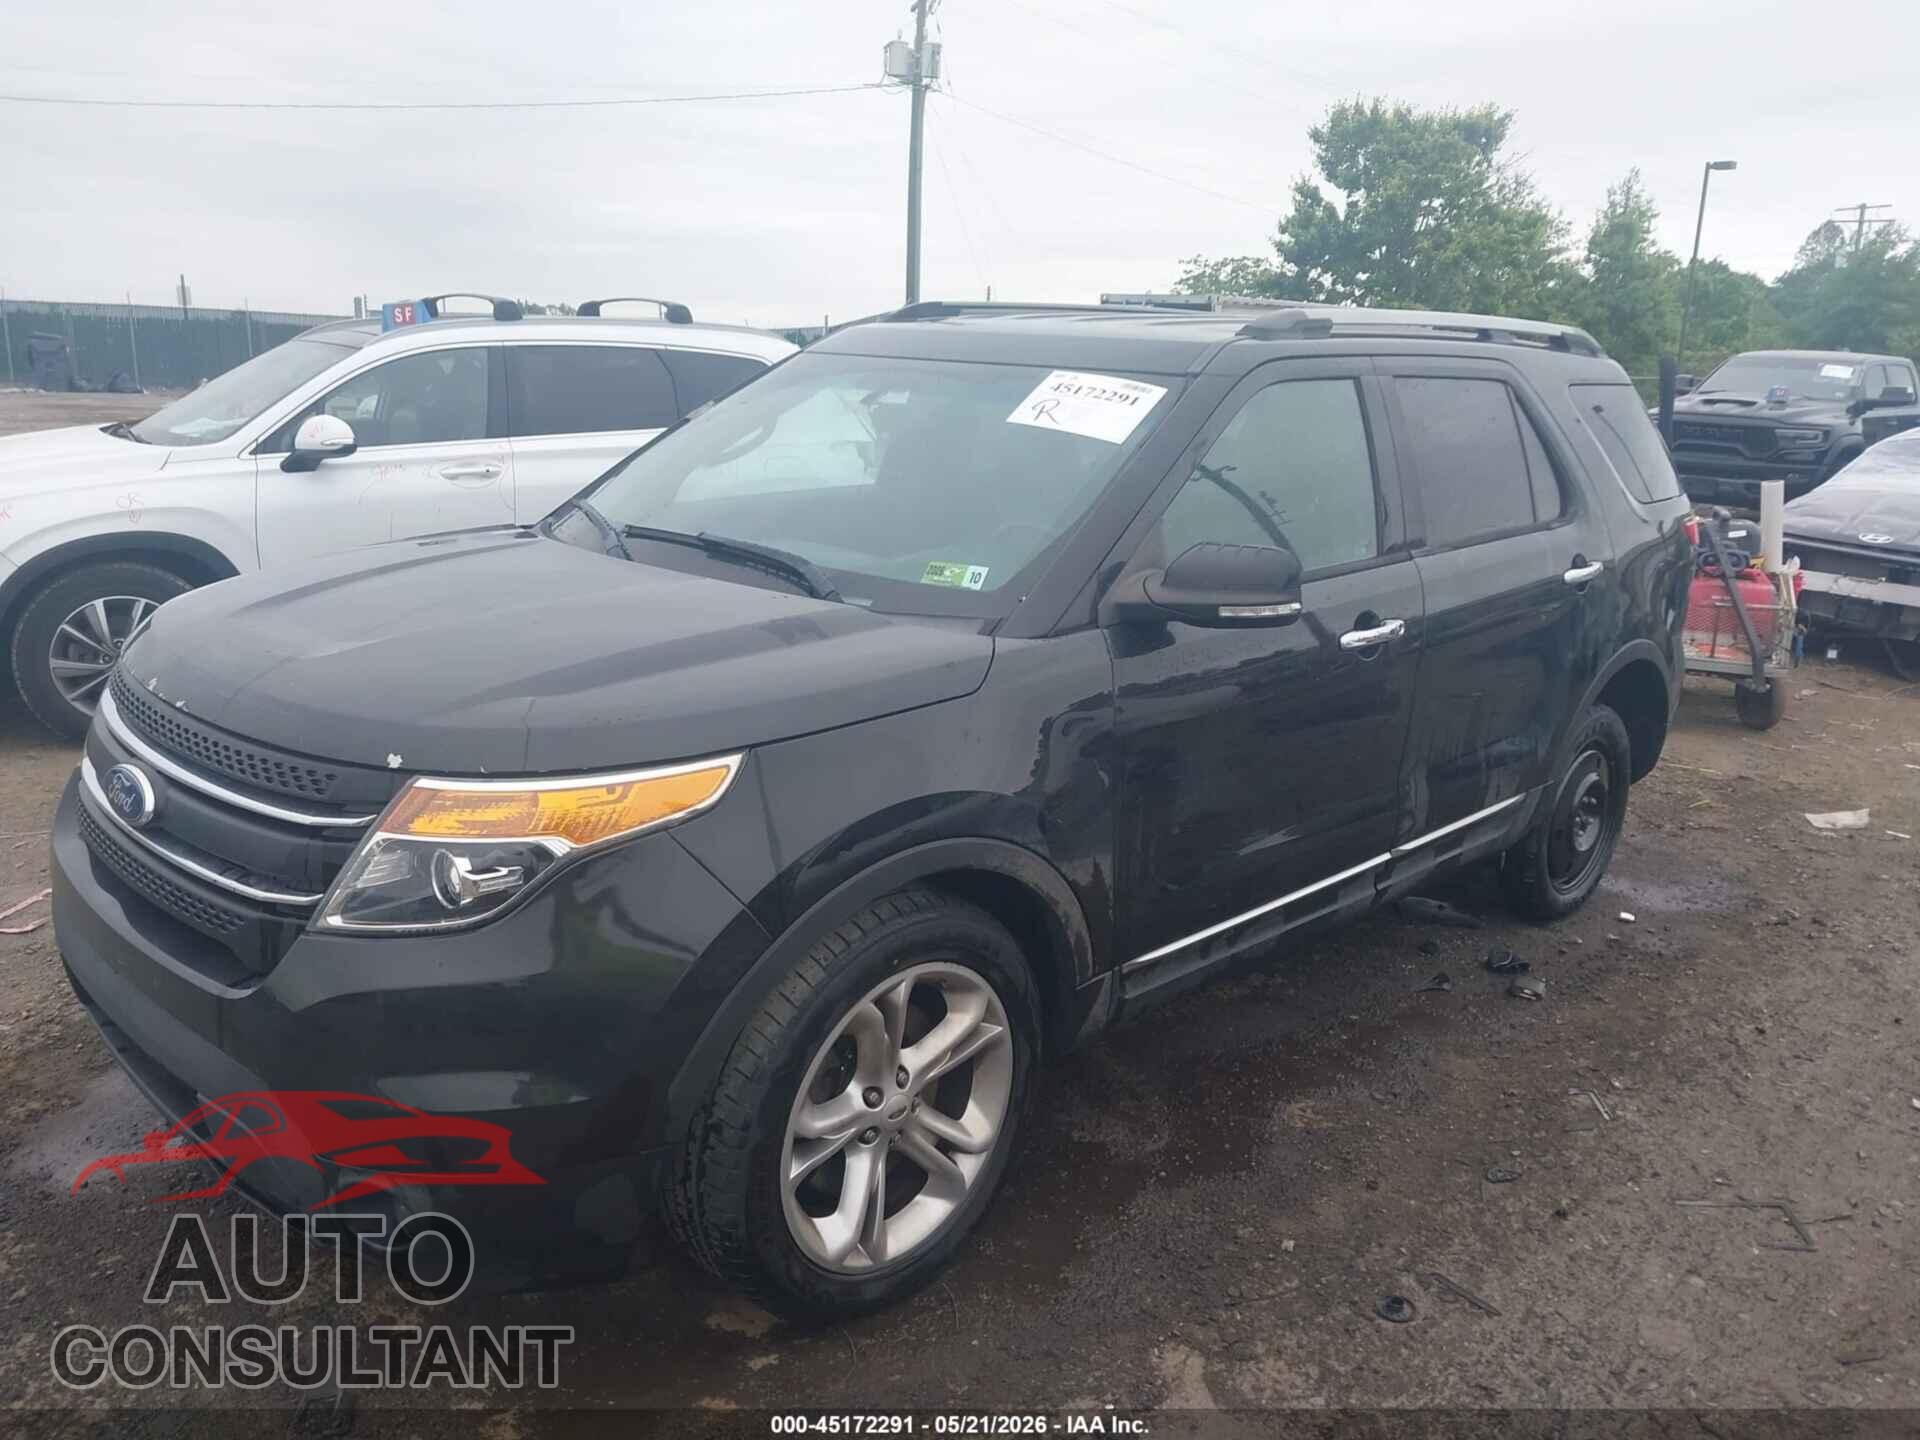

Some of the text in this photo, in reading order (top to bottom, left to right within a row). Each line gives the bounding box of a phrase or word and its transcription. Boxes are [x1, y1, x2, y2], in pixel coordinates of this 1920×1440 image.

[394, 305, 413, 322] SF
[1050, 382, 1142, 407] 45172291
[1032, 398, 1059, 425] R
[969, 571, 982, 585] 10
